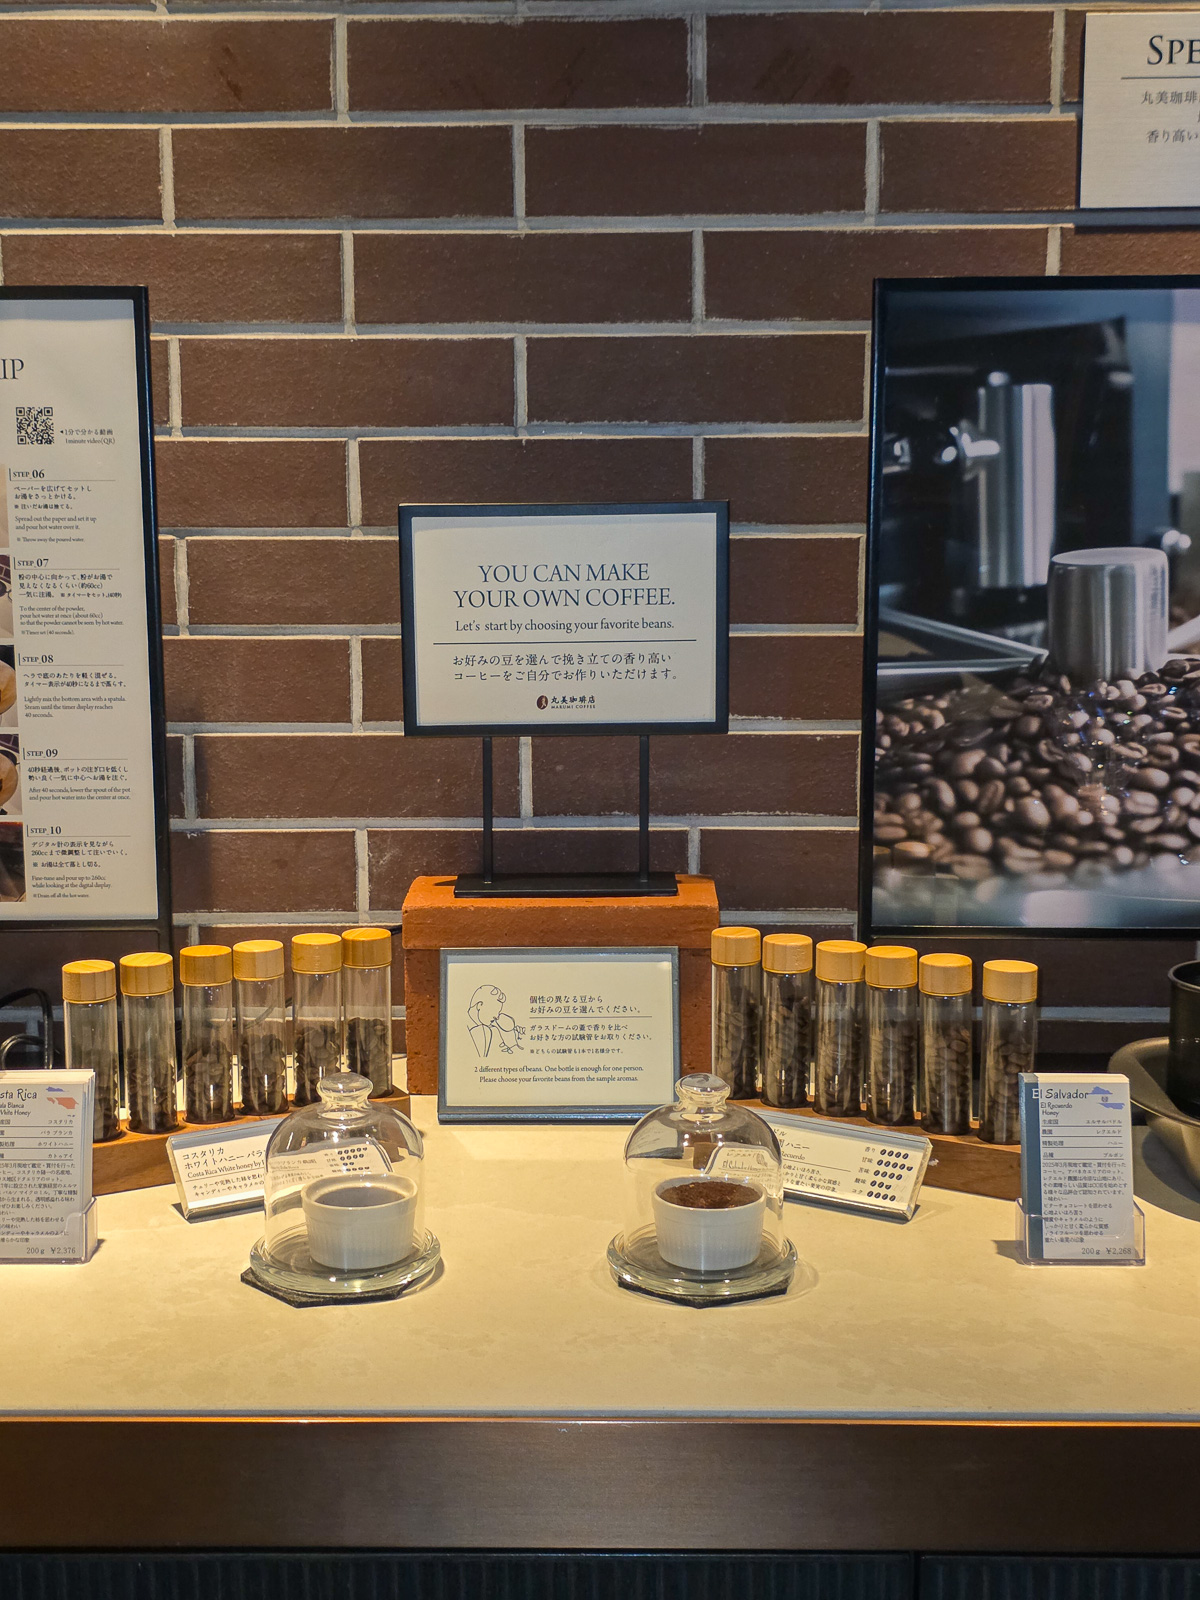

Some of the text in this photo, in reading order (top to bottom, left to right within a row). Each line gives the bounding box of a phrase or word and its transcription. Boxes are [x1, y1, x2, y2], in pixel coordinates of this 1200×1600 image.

[1141, 90, 1200, 105] 丸美珈琲
[1146, 129, 1198, 143] 香り高い
[0, 358, 25, 380] IP
[478, 563, 650, 583] YOU CAN MAKE
[453, 587, 675, 608] YOUR OWN COFFEE.
[485, 621, 508, 631] start
[510, 620, 522, 634] by
[524, 619, 572, 634] choosing
[574, 621, 598, 634] your
[600, 618, 640, 630] favorite
[642, 617, 674, 629] beans.
[453, 652, 671, 666] お好みの豆を選んで挽き立ての香り高い
[454, 668, 678, 682] コーヒーをご自分でお作りいただけます。
[551, 695, 596, 704] 丸美珈琲店
[529, 995, 603, 1004] 個性の異なる豆から
[530, 1005, 641, 1014] お好みの豆を選んでください。
[530, 1024, 628, 1032] ガラスドームの蓋で香りを比べ
[504, 1066, 518, 1074] types
[581, 1065, 601, 1074] enough
[596, 1075, 615, 1084] sample
[17, 1088, 37, 1102] Rica
[1032, 1088, 1089, 1099] El Salvador
[182, 1147, 225, 1161] コスタリカ
[184, 1155, 244, 1170] ホワイトハニー
[187, 1170, 205, 1179] Costa
[217, 1165, 236, 1173] White
